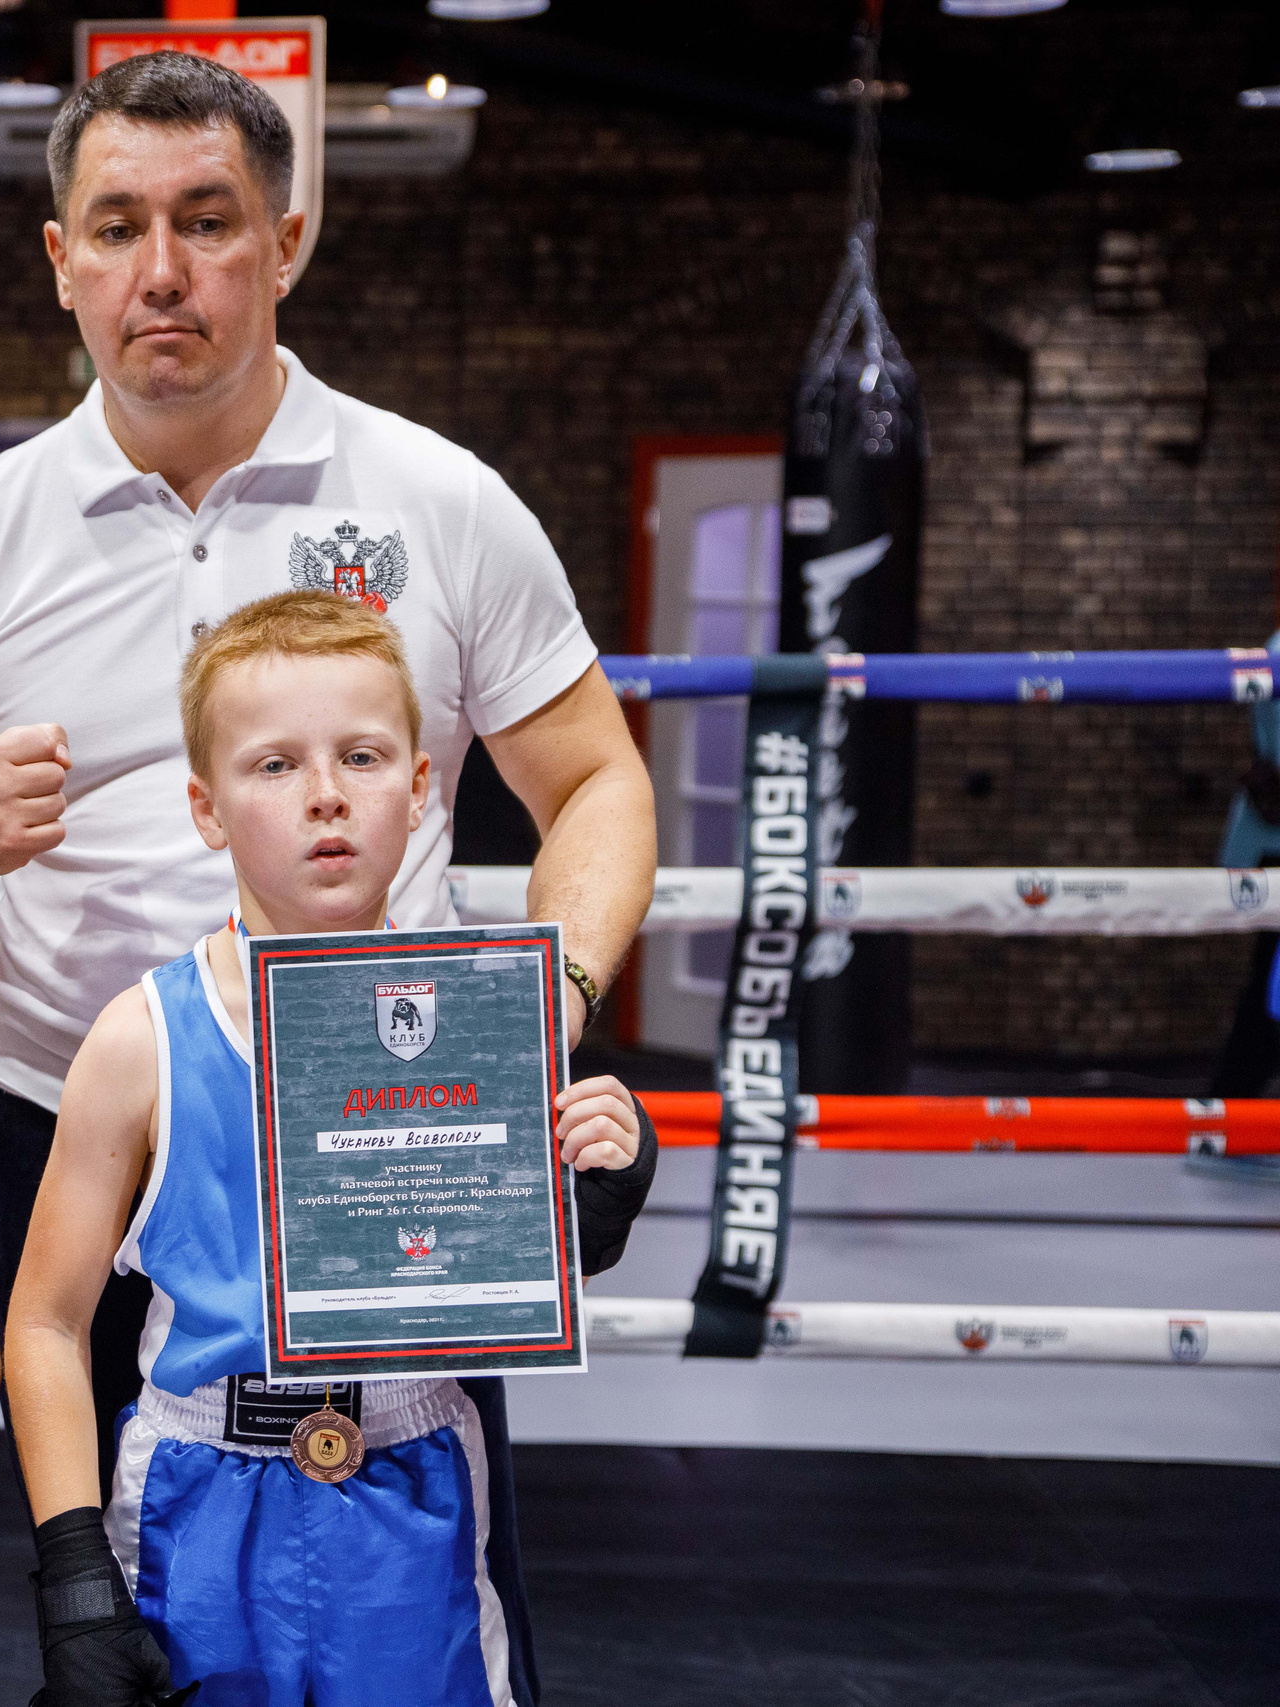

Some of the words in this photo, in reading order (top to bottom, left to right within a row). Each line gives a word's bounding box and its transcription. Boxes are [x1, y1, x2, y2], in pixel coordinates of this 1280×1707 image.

[377, 984, 432, 995] БУЛЬДОГ
[721, 730, 809, 1298] #БОКСОБЪЕДИНЯЕТ
[389, 1033, 425, 1043] КЛУБ
[343, 1083, 478, 1118] ДИПЛОМ
[385, 1163, 442, 1175] участнику
[340, 1178, 395, 1190] матчевой
[397, 1177, 443, 1188] встречи
[445, 1175, 489, 1185] команд
[298, 1194, 331, 1207] клуба
[333, 1192, 408, 1205] Единоборств
[410, 1189, 457, 1202] Бульдог
[459, 1190, 468, 1198] г.
[470, 1187, 533, 1199] Краснодар
[348, 1209, 355, 1217] и
[357, 1207, 384, 1217] Ринг
[387, 1206, 400, 1215] 26
[402, 1206, 411, 1214] г.
[413, 1203, 484, 1216] Ставрополь.
[321, 1296, 355, 1304] Руководитель
[356, 1295, 371, 1303] клуба
[255, 1416, 299, 1424] BOXING
